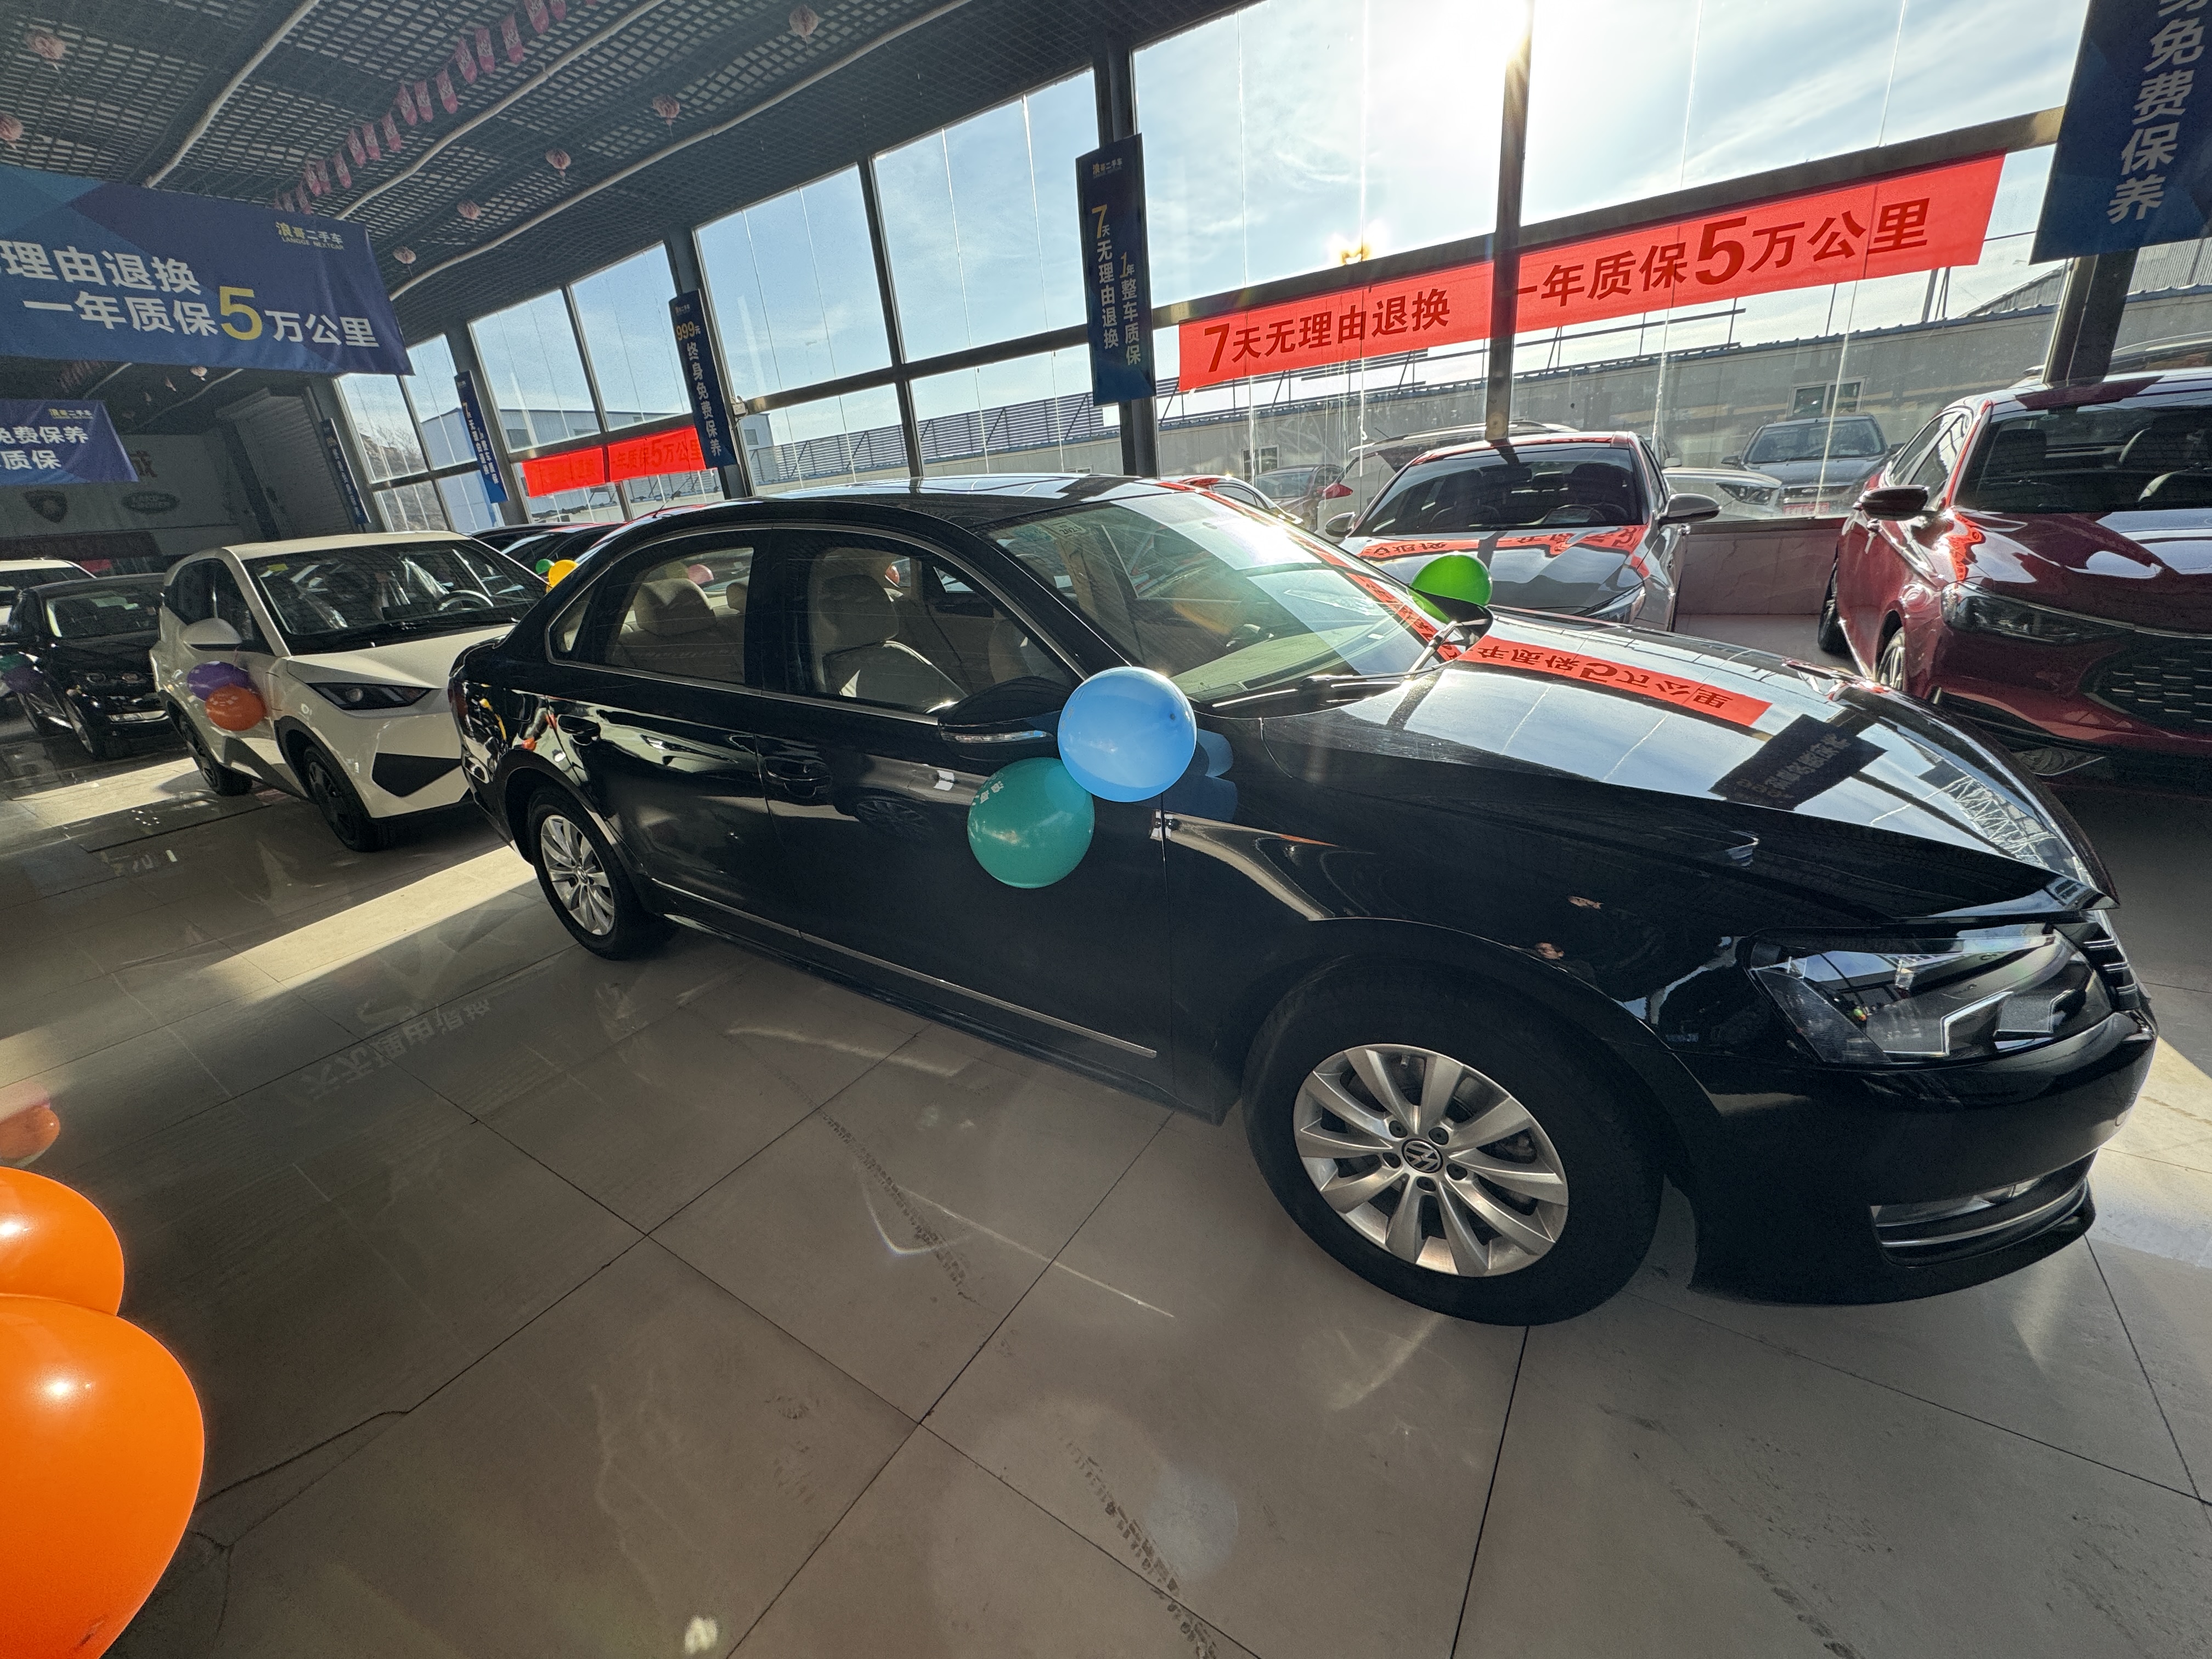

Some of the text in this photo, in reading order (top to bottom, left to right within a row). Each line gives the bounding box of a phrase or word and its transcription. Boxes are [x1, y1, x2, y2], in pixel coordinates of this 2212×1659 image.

[0, 240, 201, 295] 理由退换
[1092, 204, 1119, 349] 7天无理由退换
[1120, 251, 1142, 366] 1年整车质保
[23, 286, 380, 348] 一年质保5万公里
[676, 320, 701, 341] 999元
[1205, 288, 1450, 373] 7天无理由退换
[687, 341, 722, 456] 终身免费保养
